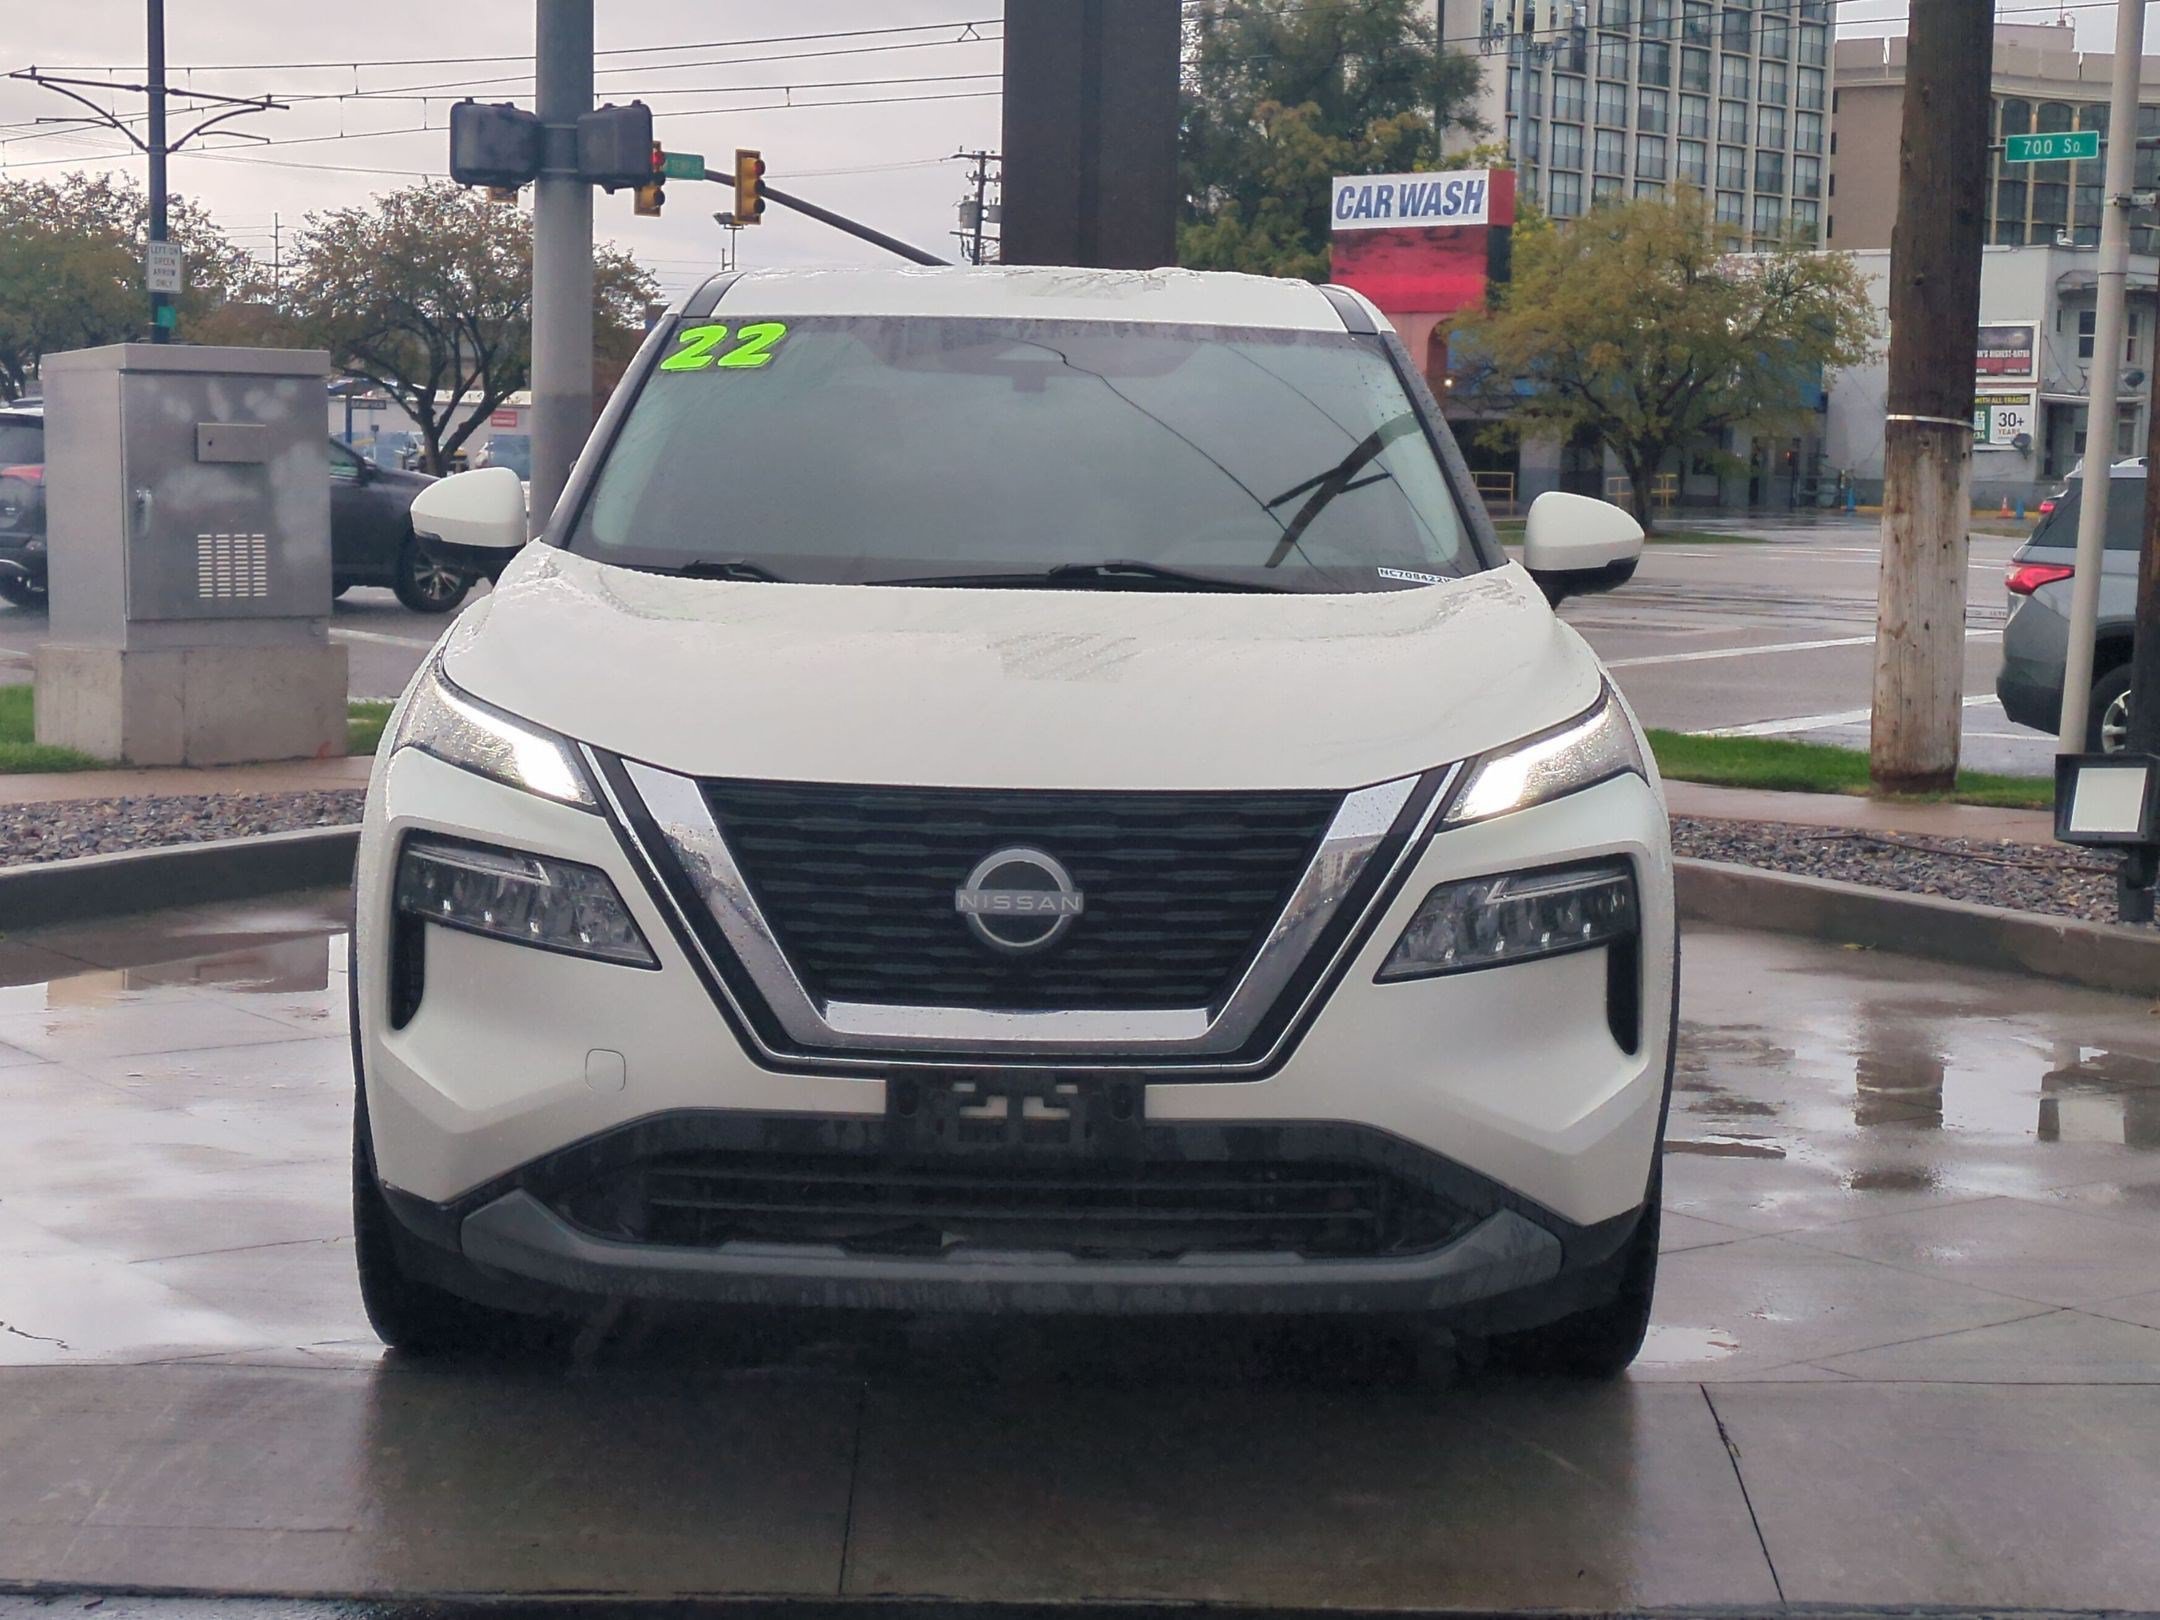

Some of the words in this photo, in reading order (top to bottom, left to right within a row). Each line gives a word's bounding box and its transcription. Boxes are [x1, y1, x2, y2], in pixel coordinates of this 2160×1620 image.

[2023, 140, 2053, 156] 700
[1335, 184, 1394, 220] CAR
[1398, 179, 1486, 218] WASH
[151, 245, 166, 255] LEFT
[154, 256, 176, 266] GREEN
[153, 267, 176, 277] ARROW
[156, 279, 173, 288] ONLY
[660, 321, 788, 372] 22
[1992, 396, 2003, 405] ALL
[1998, 411, 2025, 427] 30+
[959, 893, 1081, 912] NISSAN
